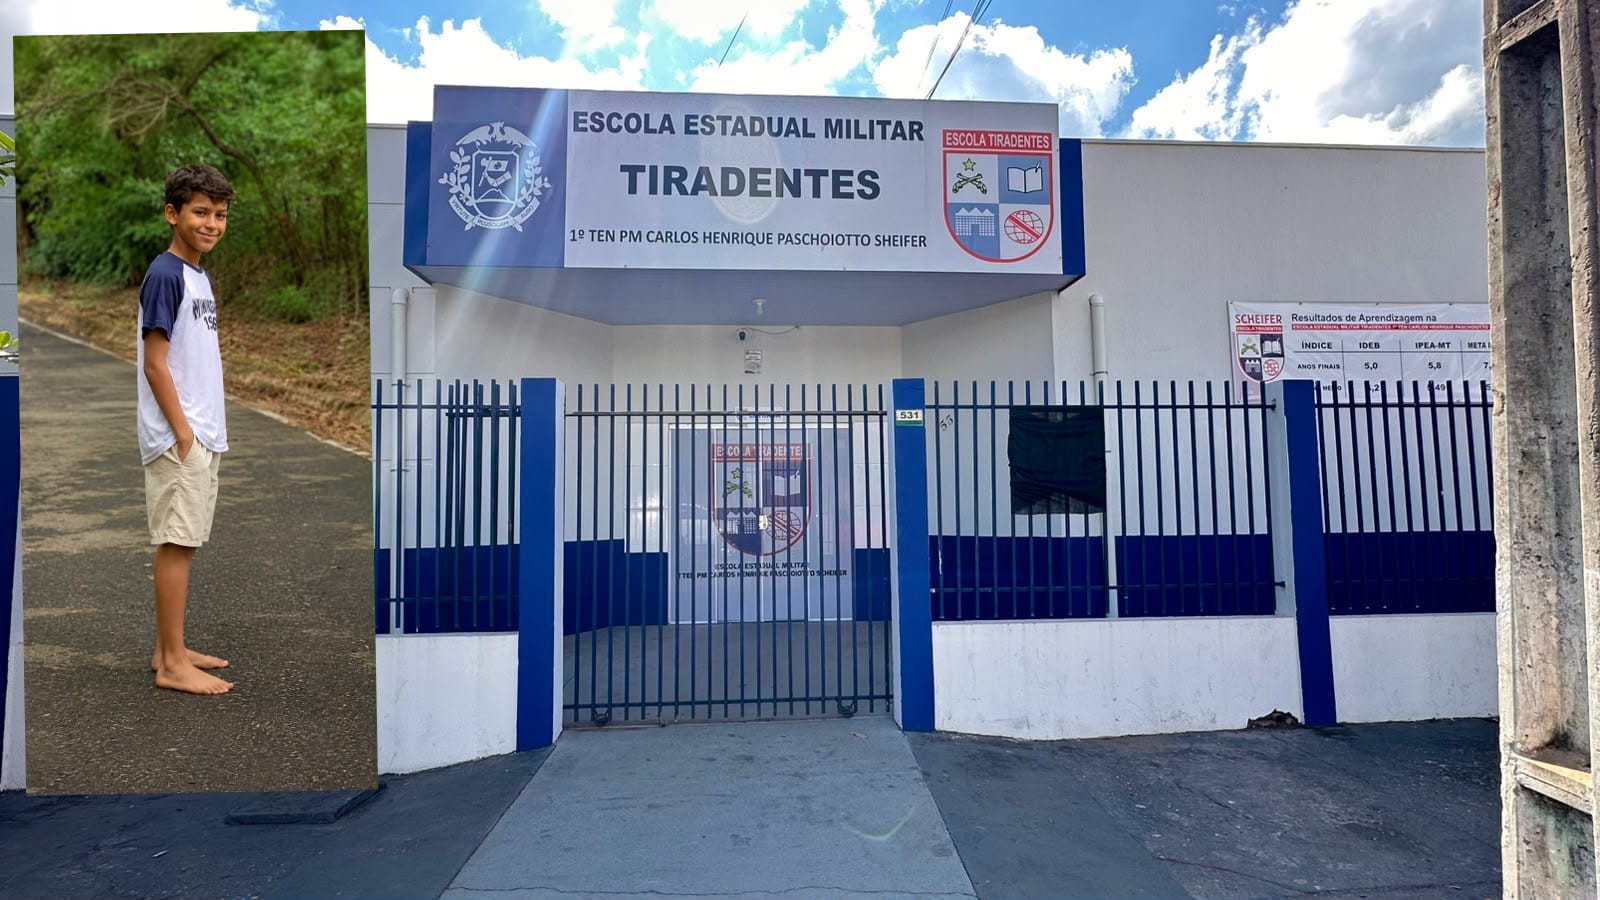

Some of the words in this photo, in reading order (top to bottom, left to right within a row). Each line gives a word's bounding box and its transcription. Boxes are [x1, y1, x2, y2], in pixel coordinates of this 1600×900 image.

[573, 111, 676, 135] ESCOLA
[684, 114, 816, 138] ESTADUAL
[824, 118, 925, 141] MILITAR
[945, 132, 986, 147] ESCOLA
[988, 133, 1049, 149] TIRADENTES
[619, 164, 881, 200] TIRADENTES
[589, 229, 615, 242] TEN
[620, 230, 642, 243] PM
[646, 230, 699, 244] CARLOS
[703, 231, 773, 246] HENRIQUE
[778, 232, 870, 247] PASCHOIOTTO
[874, 234, 927, 248] SHEIFER
[1235, 313, 1282, 324] SCHEIFER
[1291, 313, 1343, 322] Resultados
[1345, 313, 1356, 322] de
[1358, 313, 1424, 323] Aprendizagem
[1301, 340, 1333, 349] ÍNDICE
[1359, 341, 1380, 349] IDEB
[1415, 341, 1451, 349] IPEA-MT
[1467, 341, 1486, 349] META
[1364, 361, 1378, 371] 5,0
[1428, 361, 1442, 371] 5,8
[900, 411, 919, 419] 531
